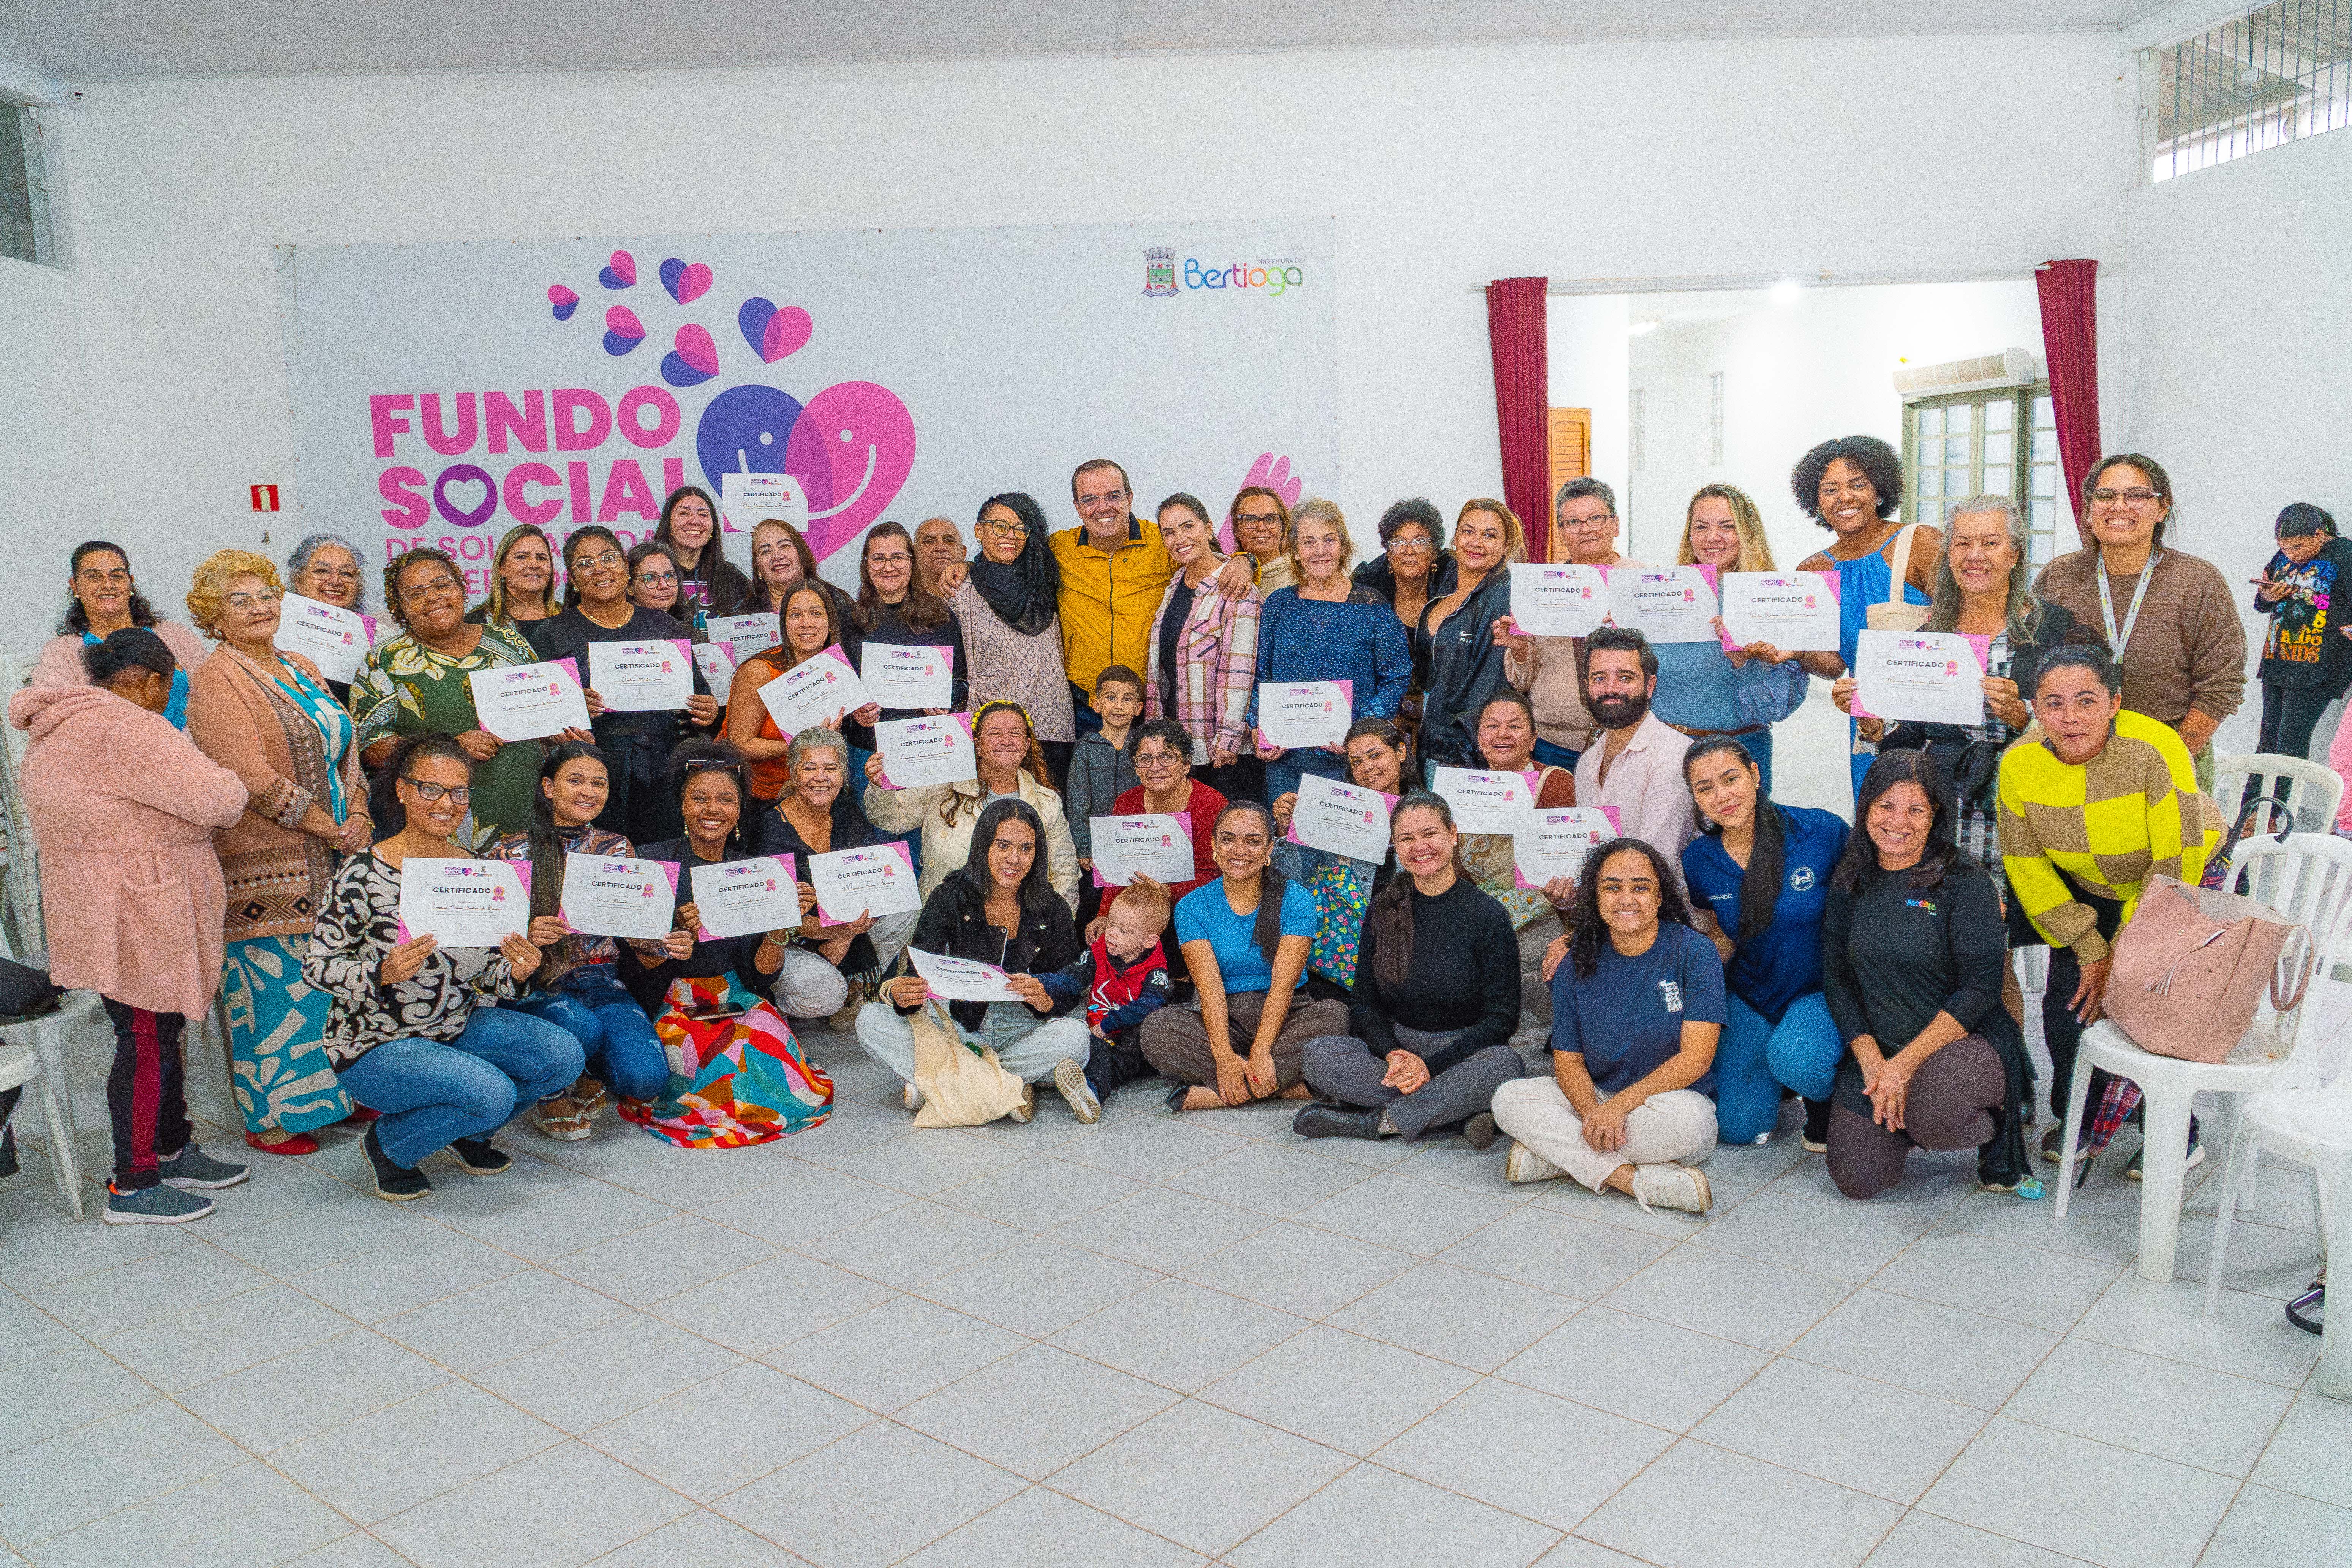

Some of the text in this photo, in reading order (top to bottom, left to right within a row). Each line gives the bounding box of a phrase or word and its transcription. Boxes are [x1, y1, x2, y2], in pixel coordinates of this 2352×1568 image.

[1185, 258, 1303, 297] Bertioga
[369, 385, 681, 458] FUNDO
[297, 620, 342, 636] CERTIFICADO
[730, 633, 768, 642] CERTIFICADO
[500, 686, 547, 697] CERTIFICADO
[788, 677, 825, 700] CERTIFICADO
[901, 738, 943, 747] CERTIFICADO
[1320, 801, 1363, 816] CERTIFICADO
[838, 868, 882, 879] CERTIFICADO
[591, 881, 642, 890] CERTIFICADO
[719, 882, 764, 893] CERTIFICADO
[936, 966, 980, 975] CERTIFICADO
